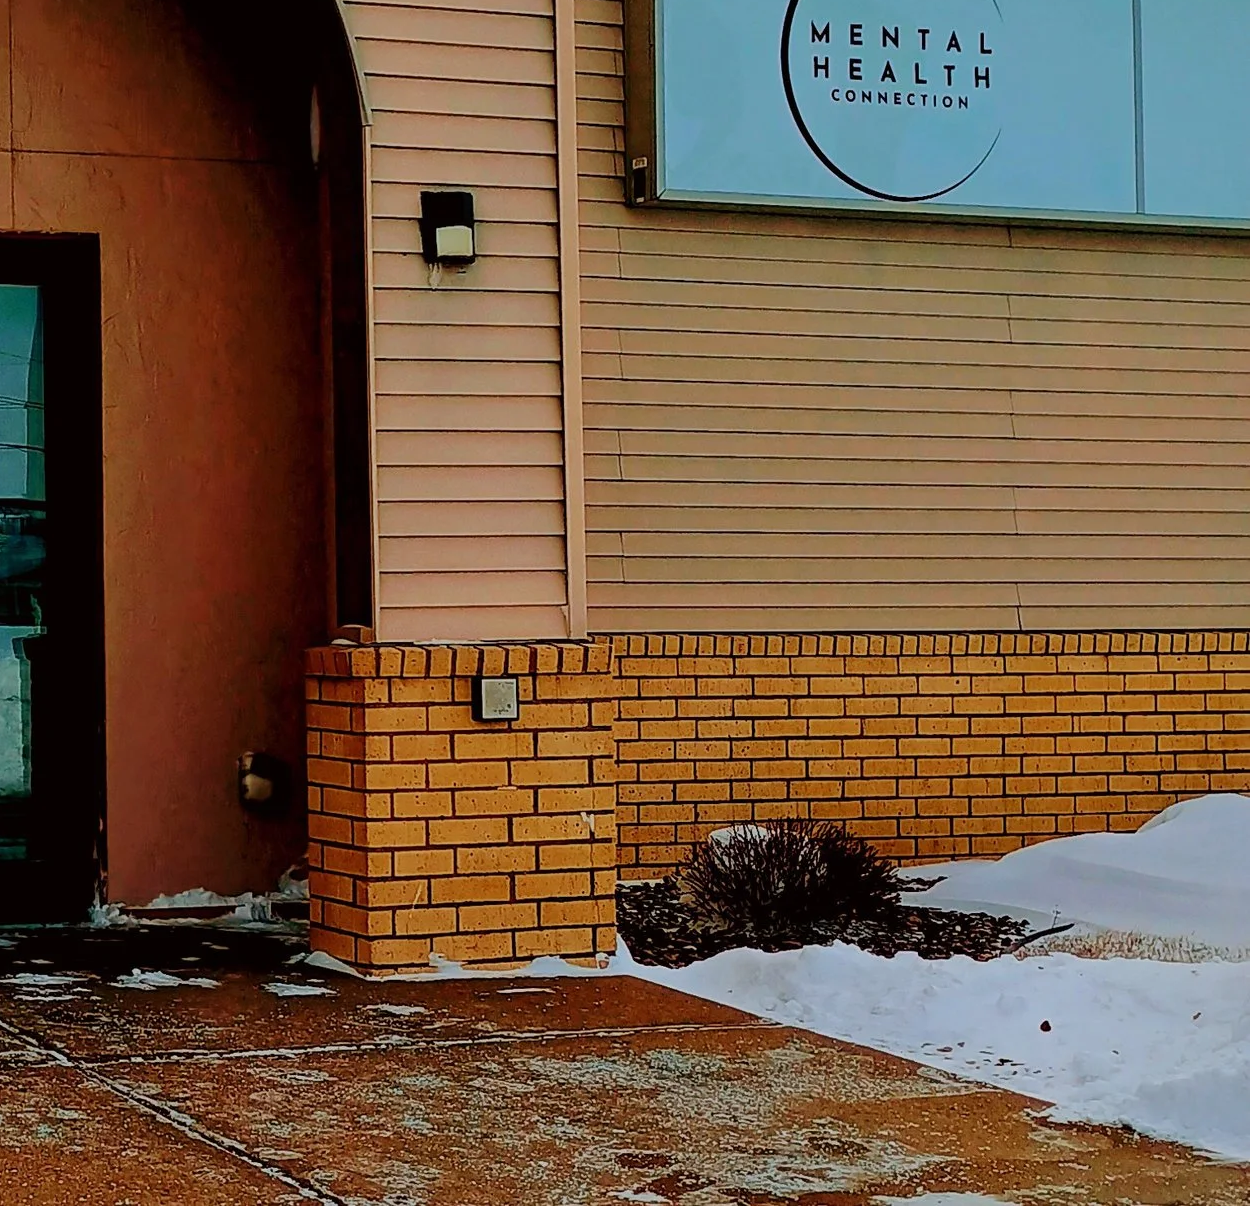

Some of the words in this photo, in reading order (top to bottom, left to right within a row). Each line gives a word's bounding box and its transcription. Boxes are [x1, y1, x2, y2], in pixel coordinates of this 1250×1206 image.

[810, 20, 993, 55] MENTAL
[813, 56, 991, 89] HEALTH
[830, 88, 969, 109] CONNECTION
